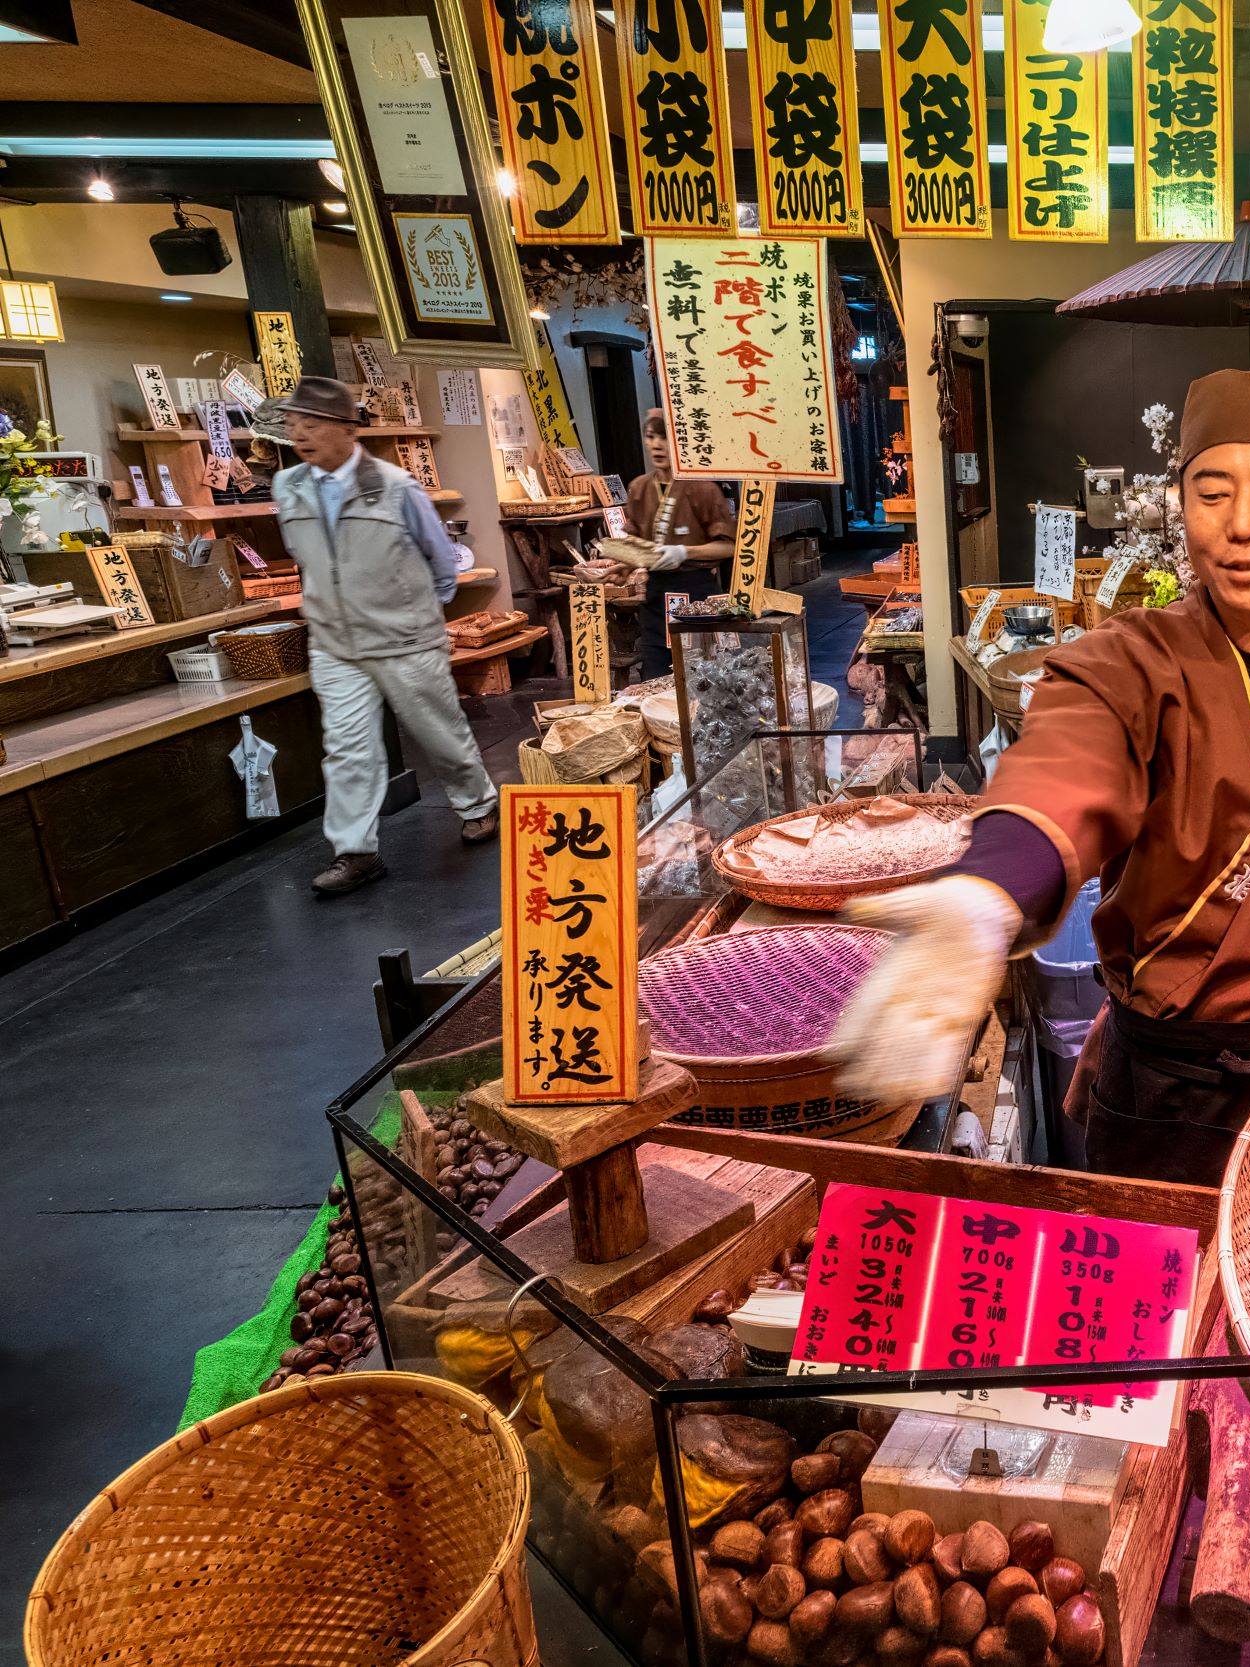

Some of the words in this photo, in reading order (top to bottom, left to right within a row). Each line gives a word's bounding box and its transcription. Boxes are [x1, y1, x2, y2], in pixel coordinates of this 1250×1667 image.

[644, 170, 719, 225] 1000円
[773, 170, 846, 225] 2000円
[904, 171, 976, 226] 3000円
[426, 249, 455, 266] BEST
[432, 272, 461, 288] 2013
[663, 259, 707, 356] 無料で
[759, 241, 788, 336] 焼ポン
[145, 368, 177, 427] 地方発送
[793, 272, 830, 472] 焼栗お買い上げのお客様
[214, 446, 232, 458] 650
[415, 440, 436, 488] 地方発送
[734, 480, 764, 613] ロングラッセ
[104, 551, 147, 625] 地方発送
[518, 801, 556, 926] 焼き栗
[543, 807, 614, 1086] 地方発送
[521, 949, 551, 1091] 承ります。
[860, 1199, 917, 1235] 大
[962, 1213, 1021, 1245] 中
[1058, 1225, 1121, 1260] 小
[818, 1234, 839, 1286] まいど
[860, 1232, 914, 1258] 1050g
[962, 1246, 1015, 1271] 700g
[1061, 1259, 1115, 1284] 350g
[1159, 1248, 1183, 1324] 焼ポン
[1120, 1298, 1152, 1414] おしなき
